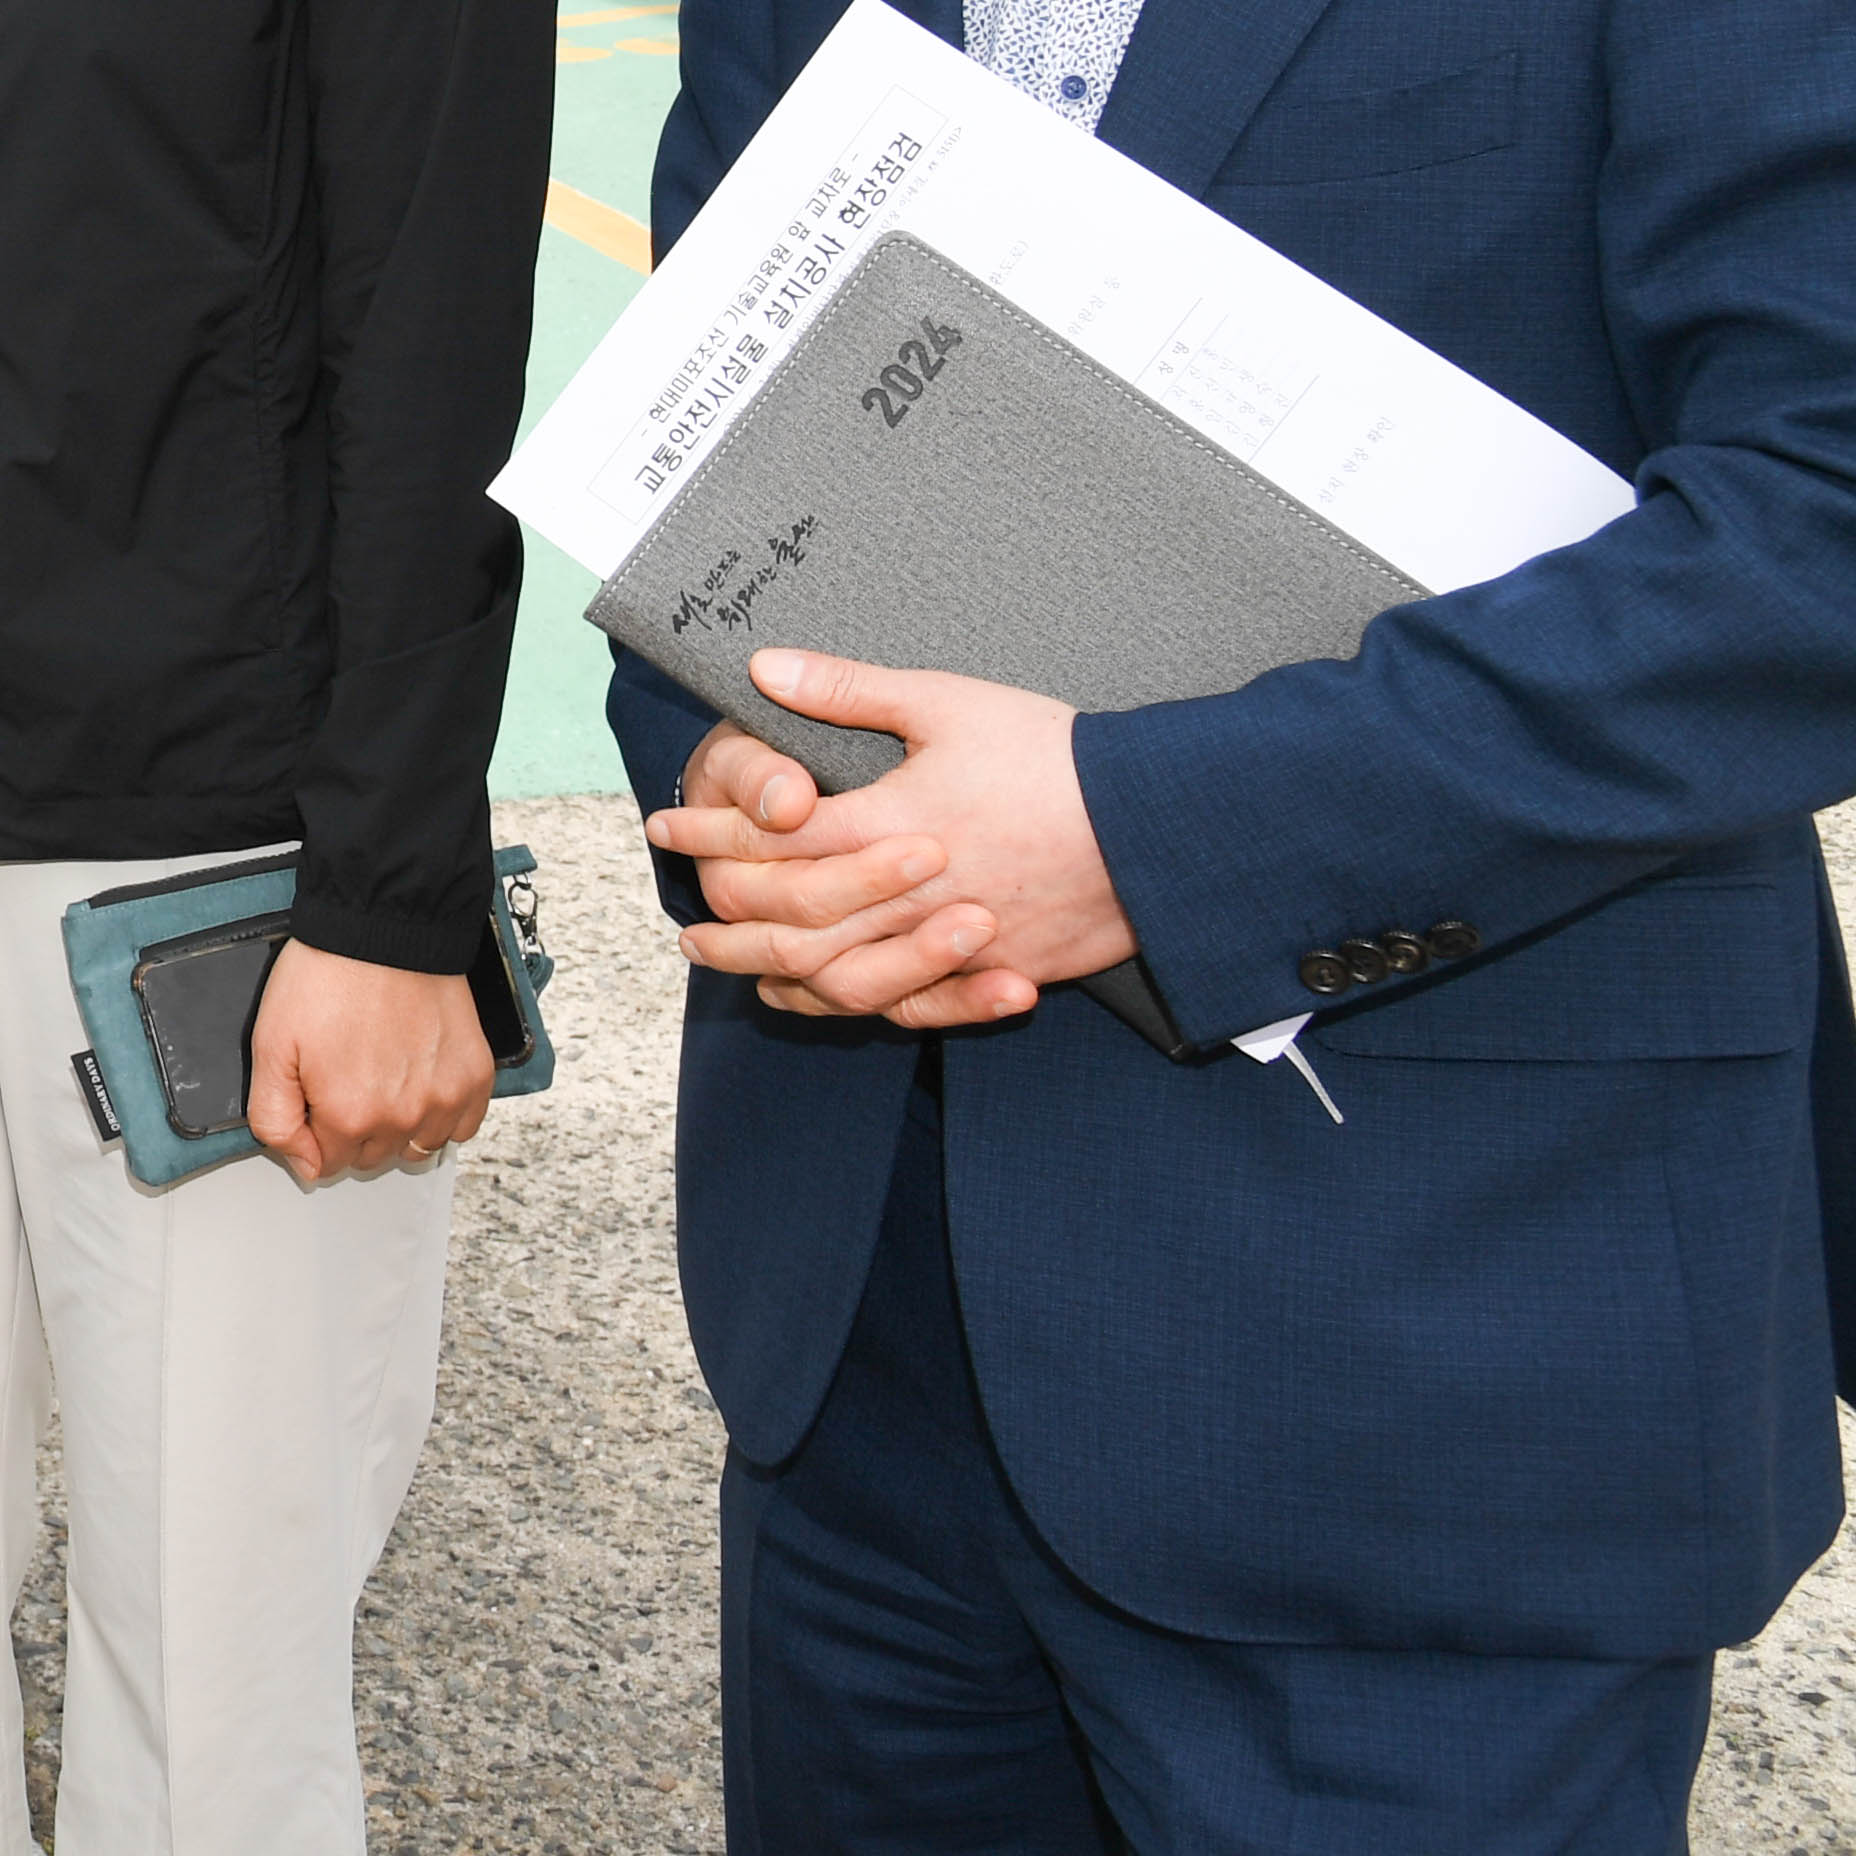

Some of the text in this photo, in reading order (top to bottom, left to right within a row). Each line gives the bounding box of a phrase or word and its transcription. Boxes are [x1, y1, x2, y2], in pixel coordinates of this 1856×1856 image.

[634, 334, 769, 495] 교통안전시설물
[763, 233, 846, 330] 설치공사
[838, 132, 923, 230] 현장점검
[648, 328, 729, 424] 현대미포조선
[724, 243, 794, 325] 기술교육원
[788, 220, 812, 241] 앞
[805, 168, 852, 219] 교차로
[862, 316, 962, 429] 2024
[768, 515, 819, 567] 울산
[83, 1056, 121, 1132] ORDINARY DAYS
